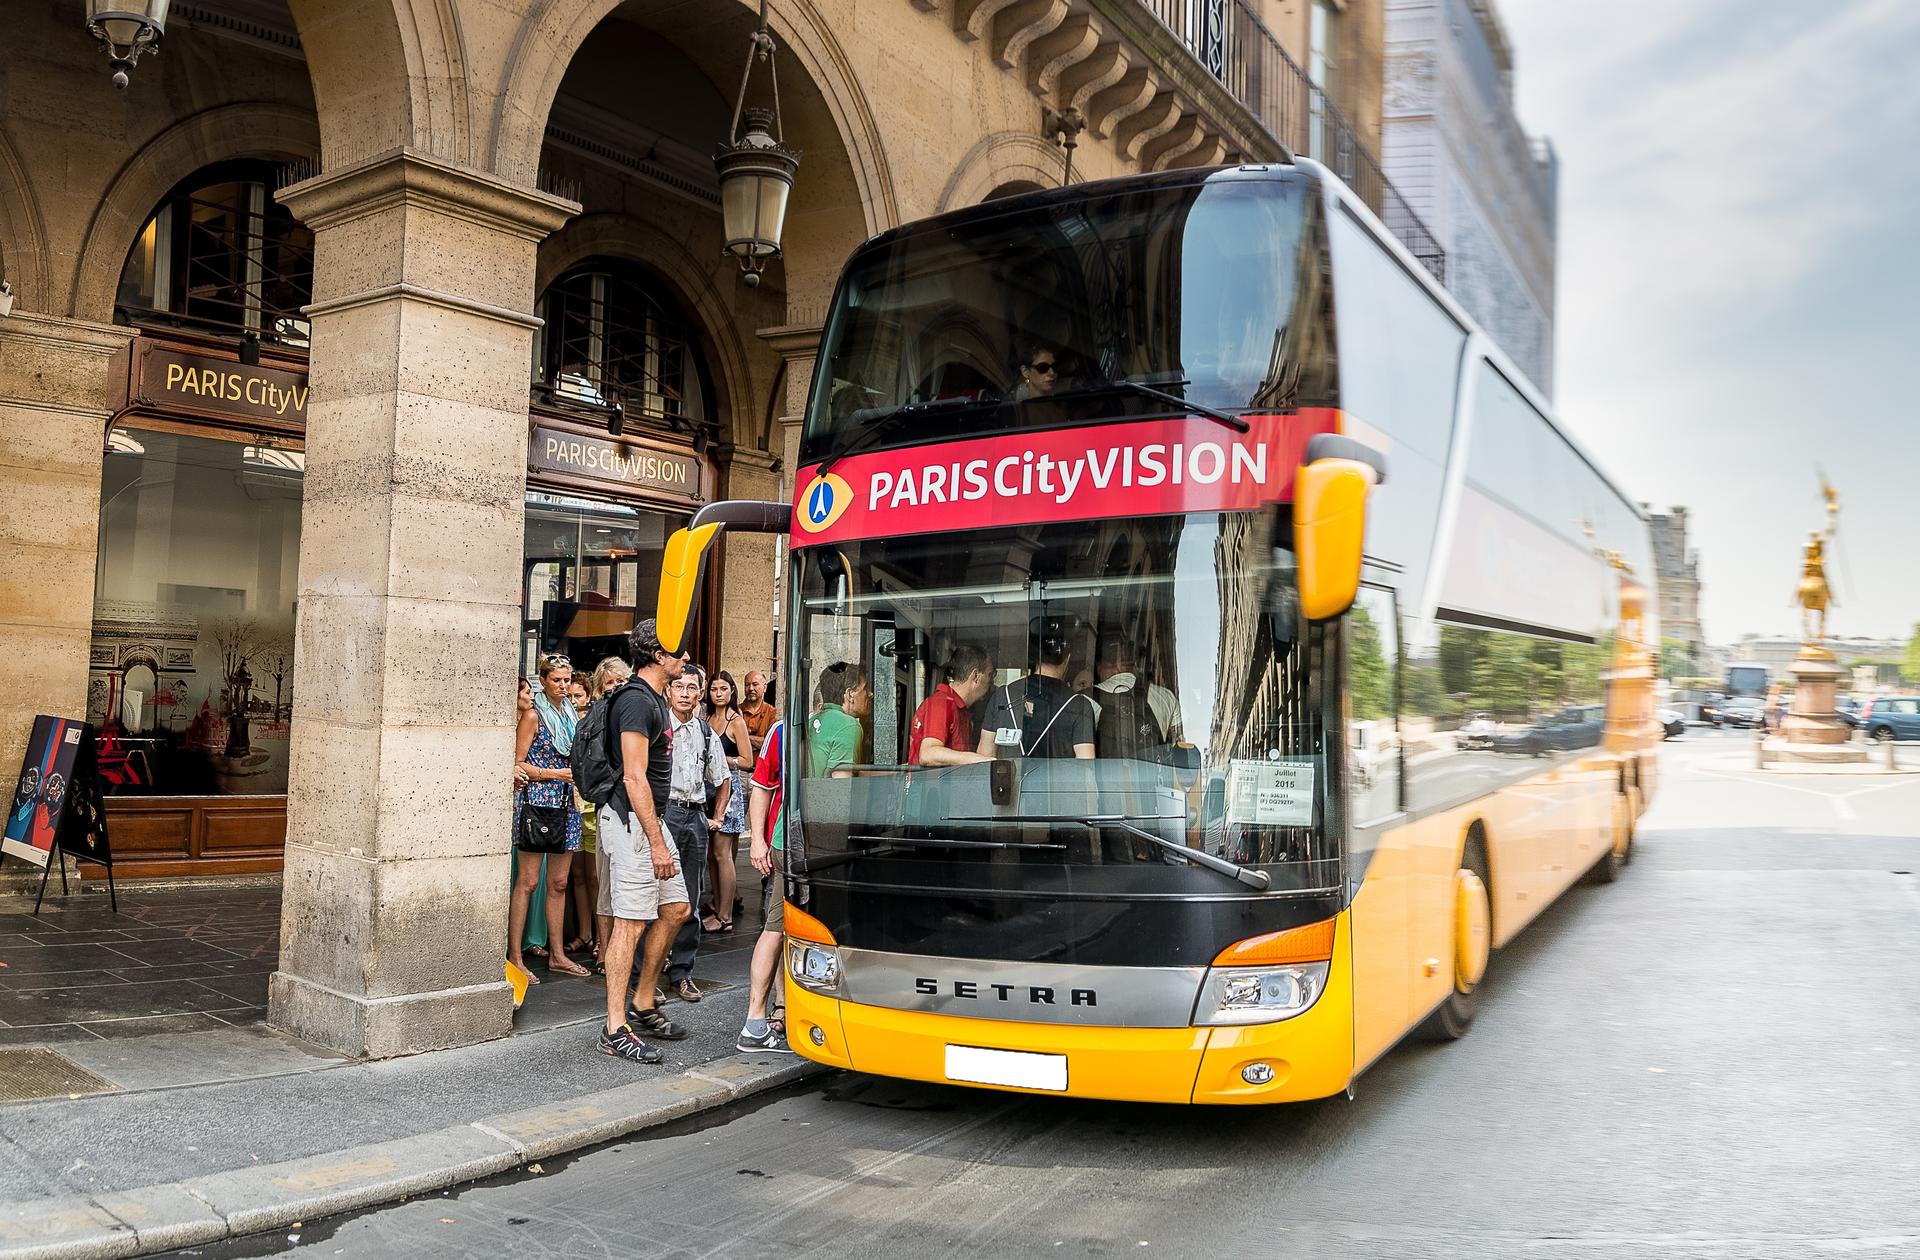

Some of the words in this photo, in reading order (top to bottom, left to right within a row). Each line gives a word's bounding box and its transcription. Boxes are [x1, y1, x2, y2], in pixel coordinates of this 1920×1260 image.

[545, 437, 687, 484] PARISCityVISION
[867, 442, 1268, 504] PARISCityVISION
[1275, 780, 1295, 788] 2015
[915, 977, 1097, 1007] SETRA
